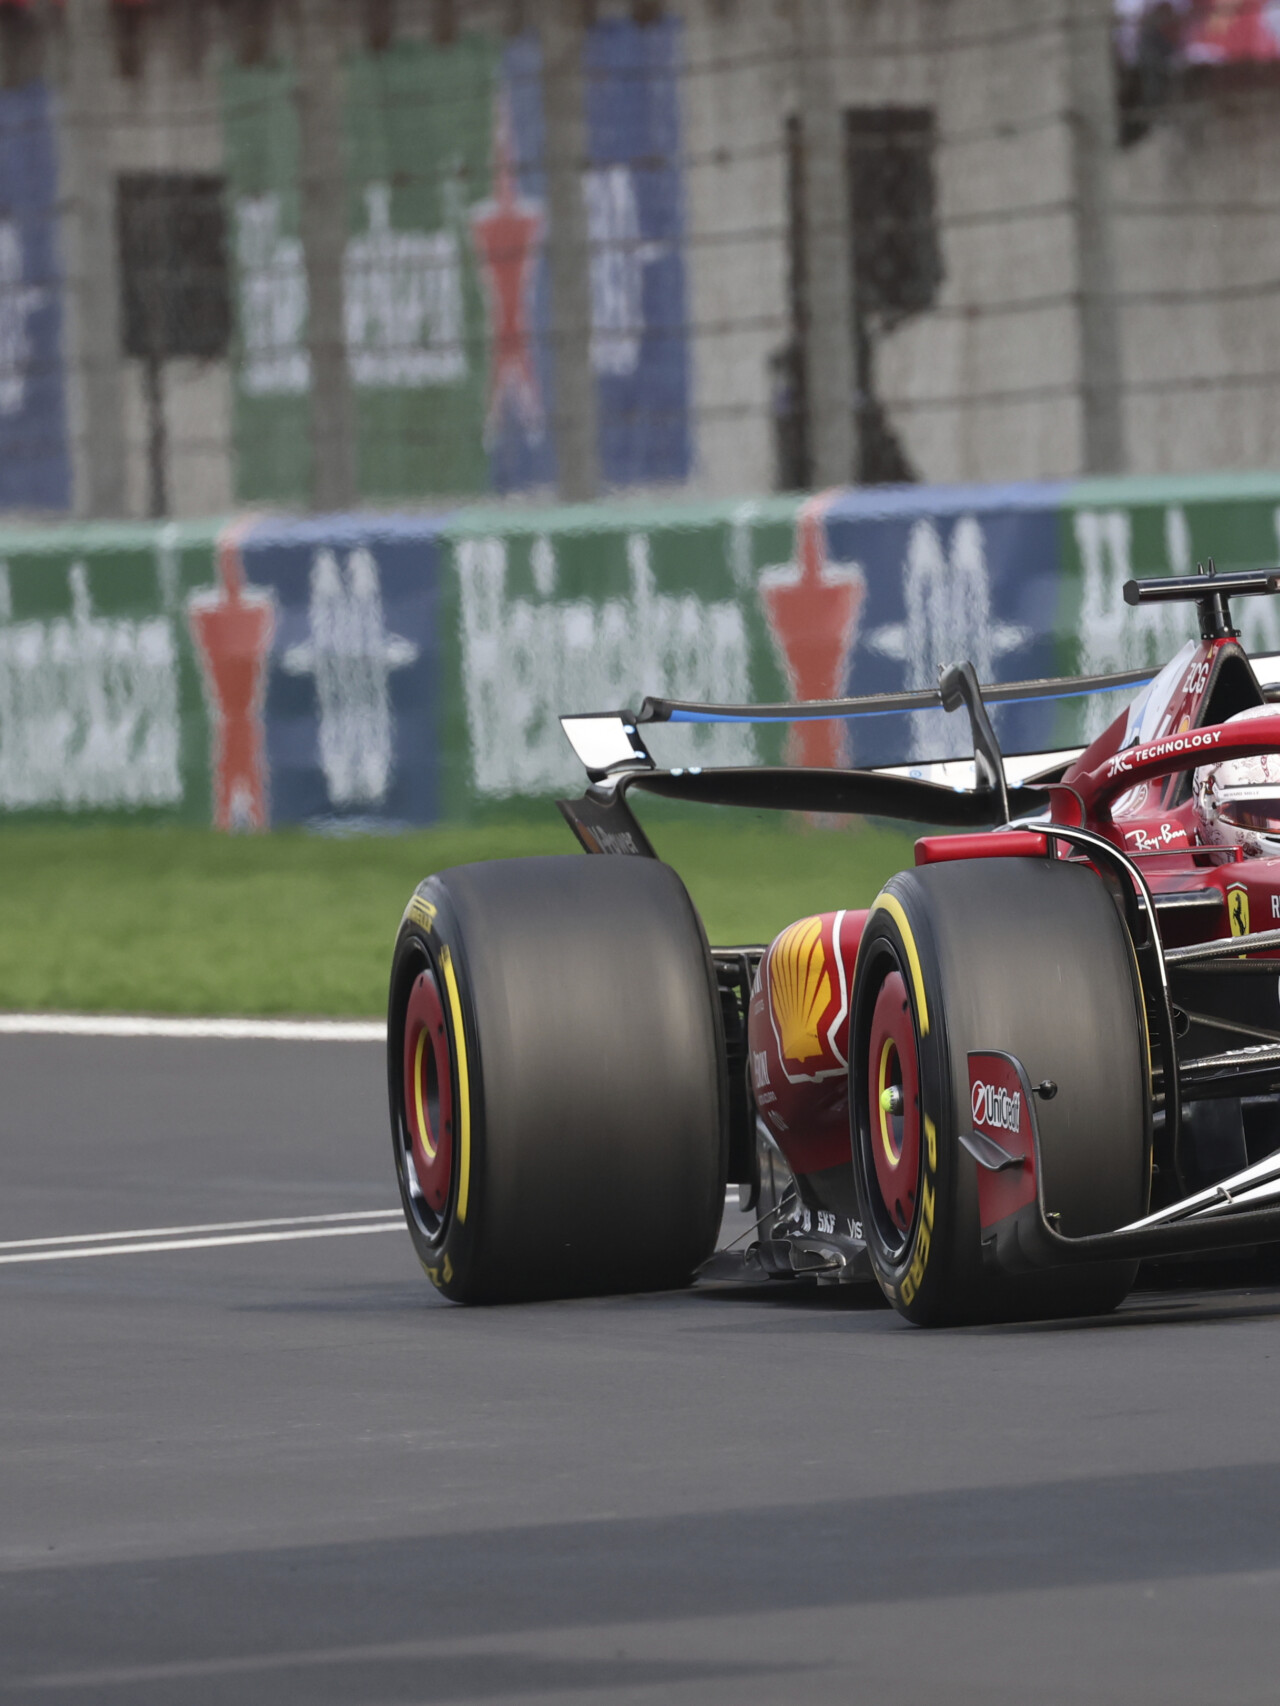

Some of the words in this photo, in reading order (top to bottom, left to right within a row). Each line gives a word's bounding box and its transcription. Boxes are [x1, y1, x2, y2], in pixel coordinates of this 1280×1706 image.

[1135, 731, 1222, 762] TECHNOLOGY
[1125, 824, 1187, 851] Ray-Ban
[985, 1083, 1021, 1133] UniCredit
[817, 1210, 836, 1234] SKF
[846, 1218, 863, 1239] VIS
